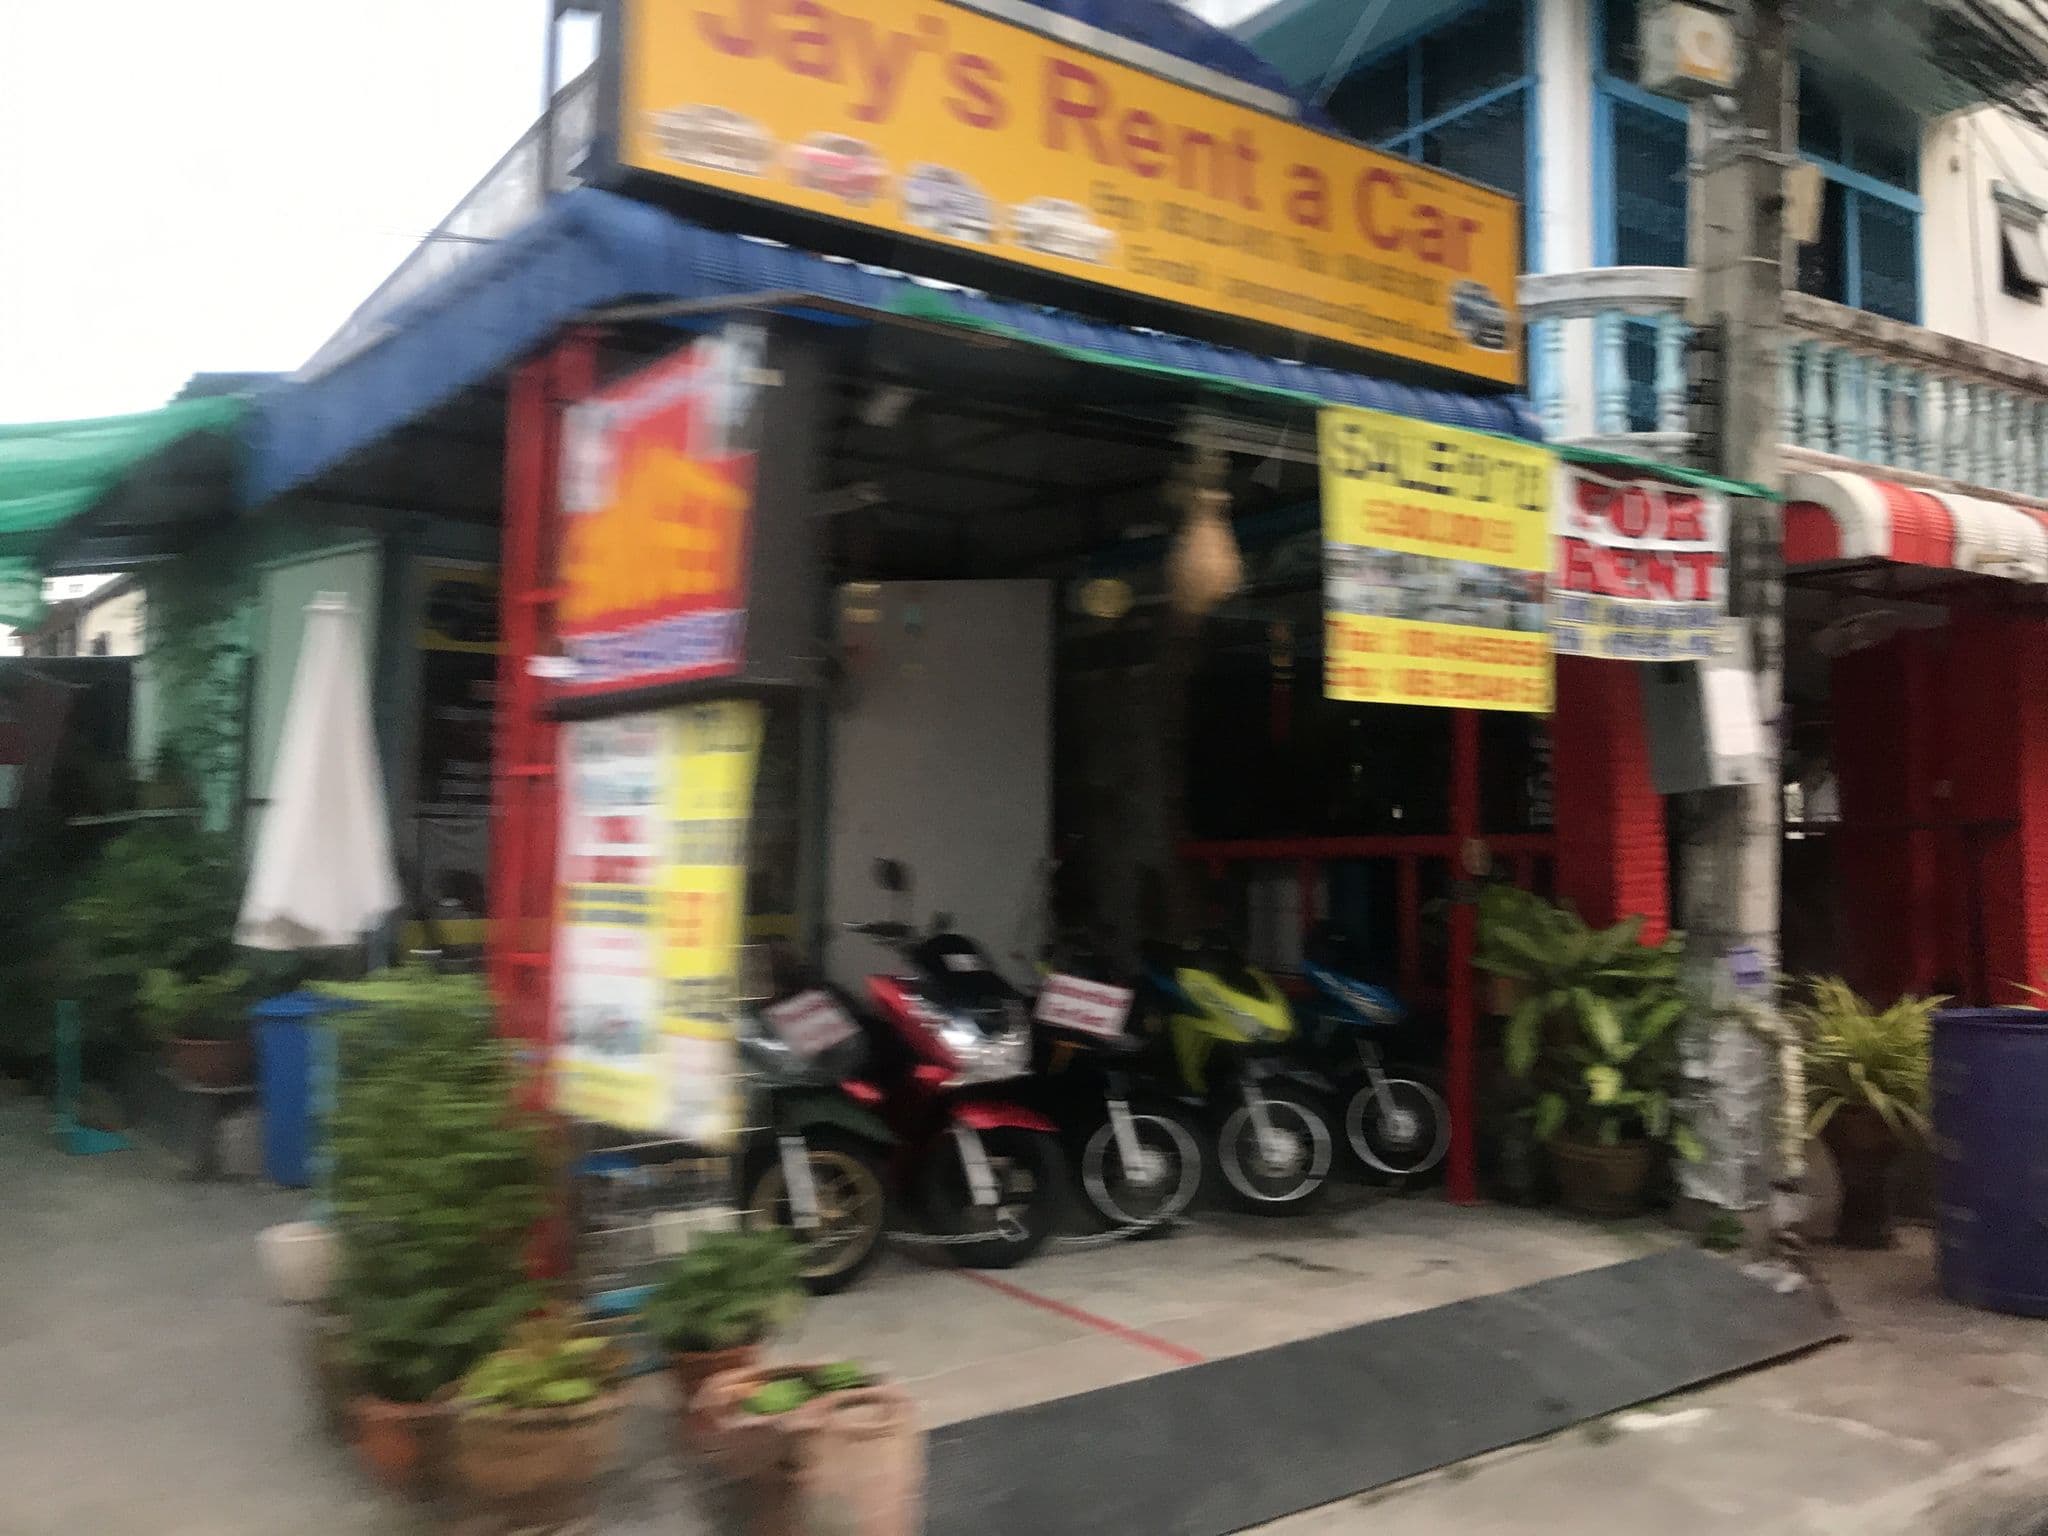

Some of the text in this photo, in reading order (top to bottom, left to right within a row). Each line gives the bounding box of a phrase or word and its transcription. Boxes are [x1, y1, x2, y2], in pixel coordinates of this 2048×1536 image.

[693, 0, 1014, 132] Jay's
[1037, 53, 1262, 213] Rent
[1285, 162, 1335, 234] a
[1351, 165, 1484, 273] Car
[1328, 422, 1459, 497] SALE
[1571, 474, 1709, 544] FOR
[1556, 534, 1726, 602] RENT
